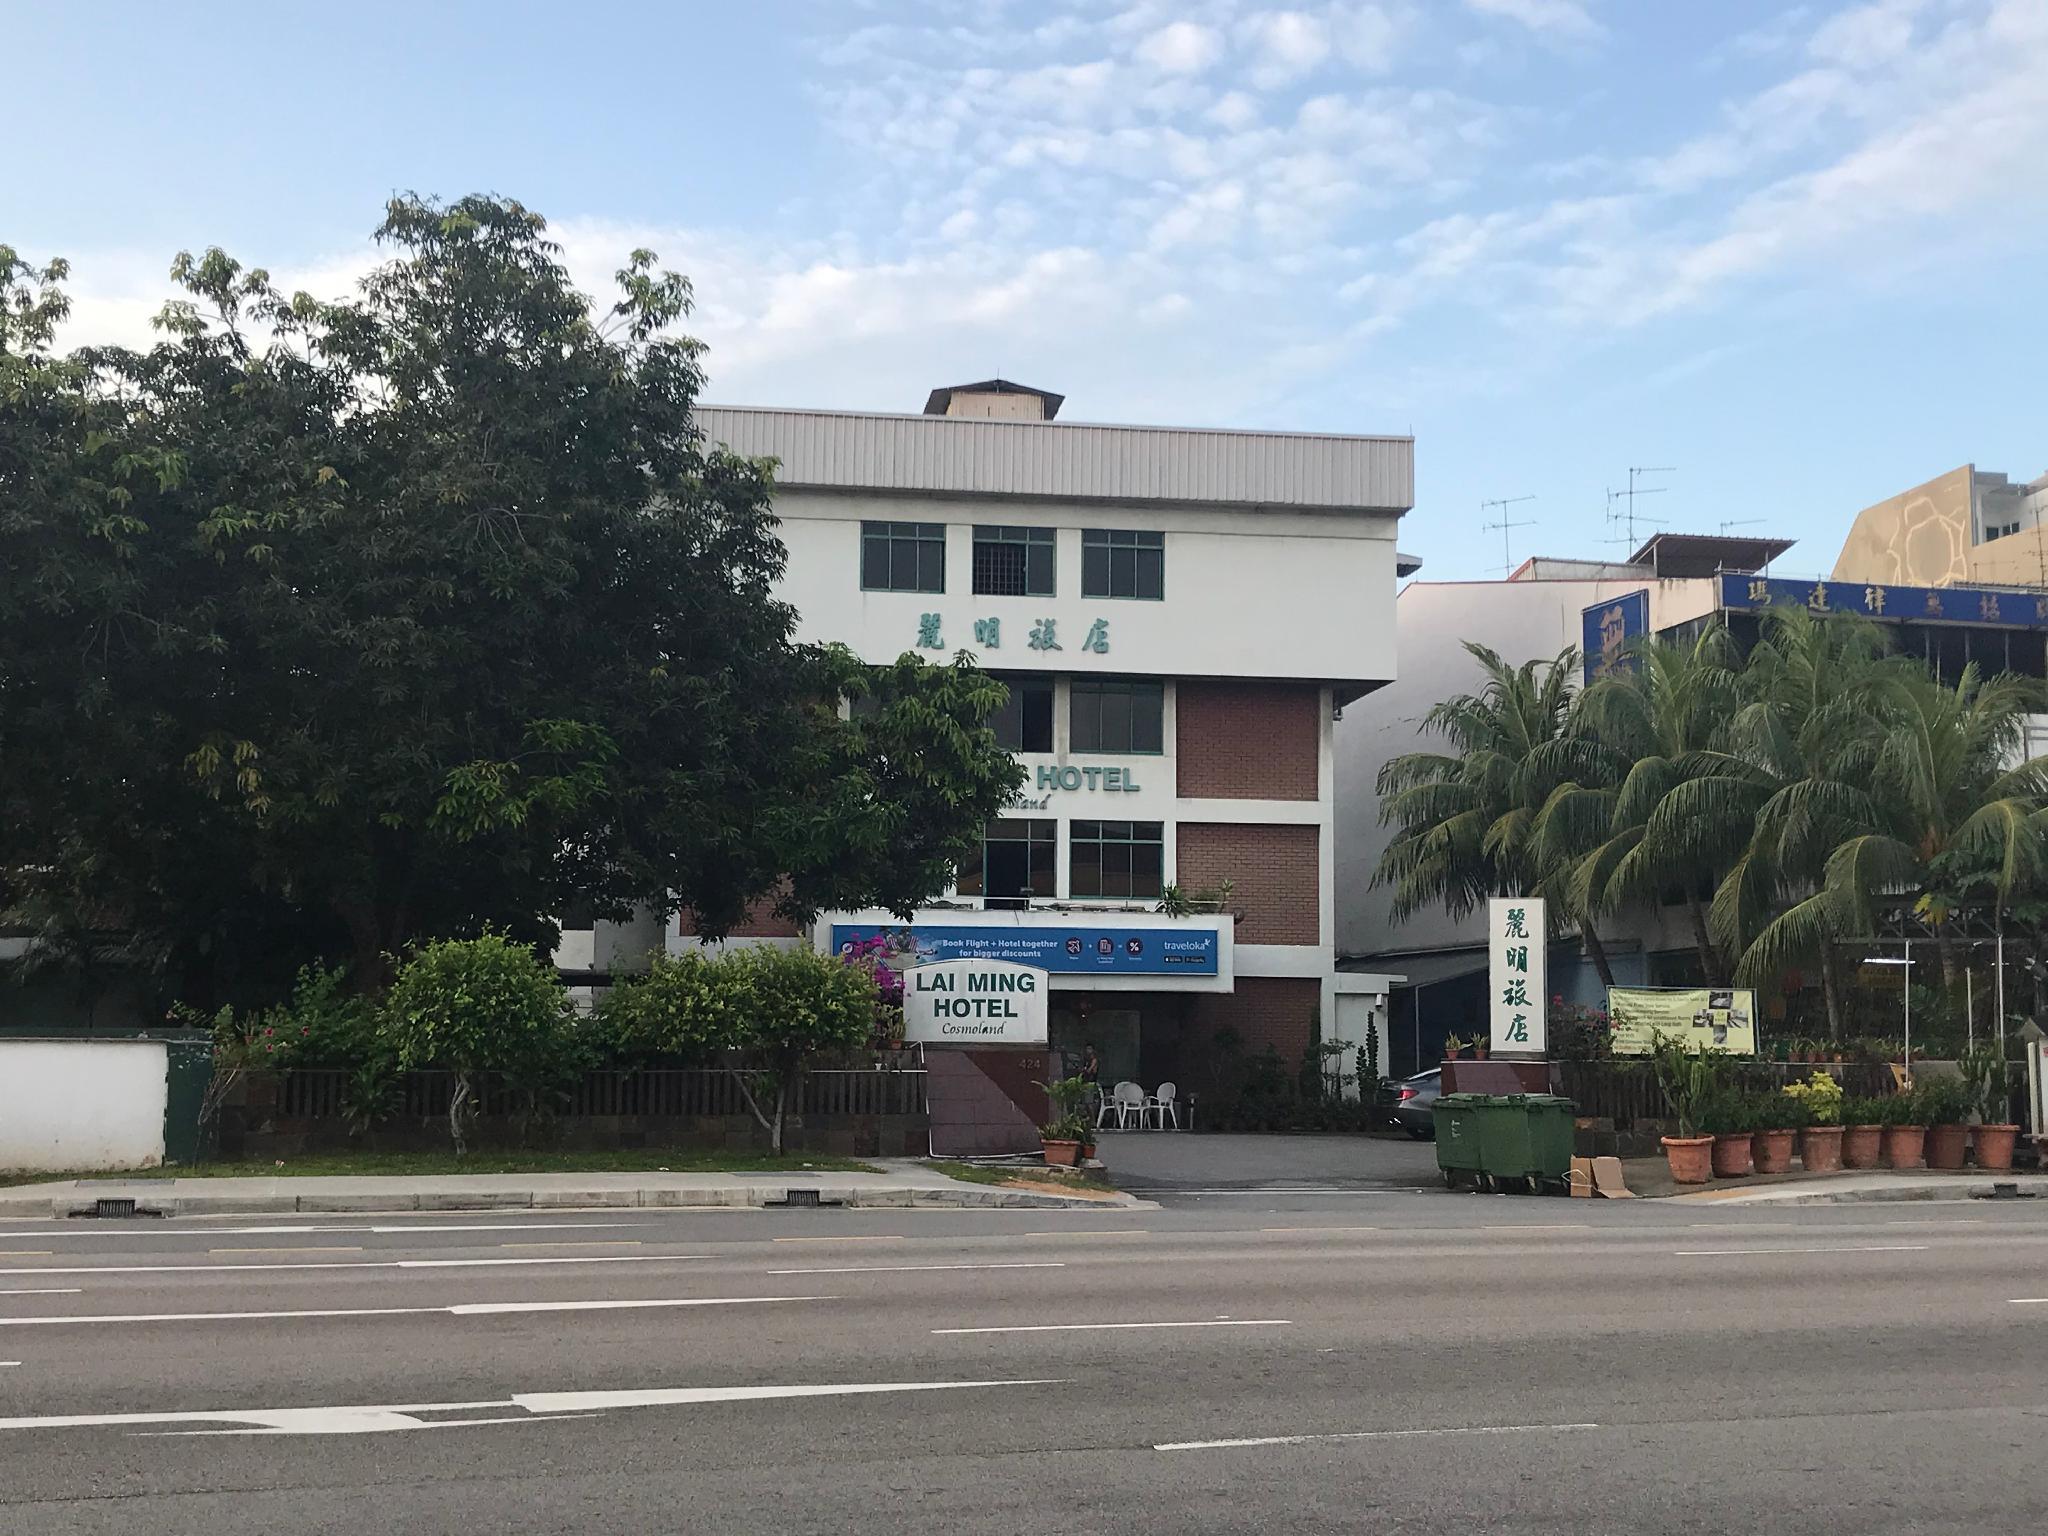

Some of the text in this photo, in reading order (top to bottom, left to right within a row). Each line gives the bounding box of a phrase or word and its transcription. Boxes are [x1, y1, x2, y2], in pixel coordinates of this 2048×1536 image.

[1037, 765, 1141, 792] HOTEL
[942, 939, 964, 947] Book
[965, 939, 989, 949] Flight
[998, 939, 1021, 947] Hotel
[1022, 940, 1058, 949] together
[1164, 941, 1206, 951] traveloka
[959, 949, 1041, 958] for bigger discounts
[1502, 908, 1533, 1043] 麗明旅店
[916, 973, 1035, 993] LAI MING
[934, 998, 1018, 1018] HOTEL
[942, 1021, 1008, 1035] Cosmoland
[1019, 1059, 1041, 1069] 424
